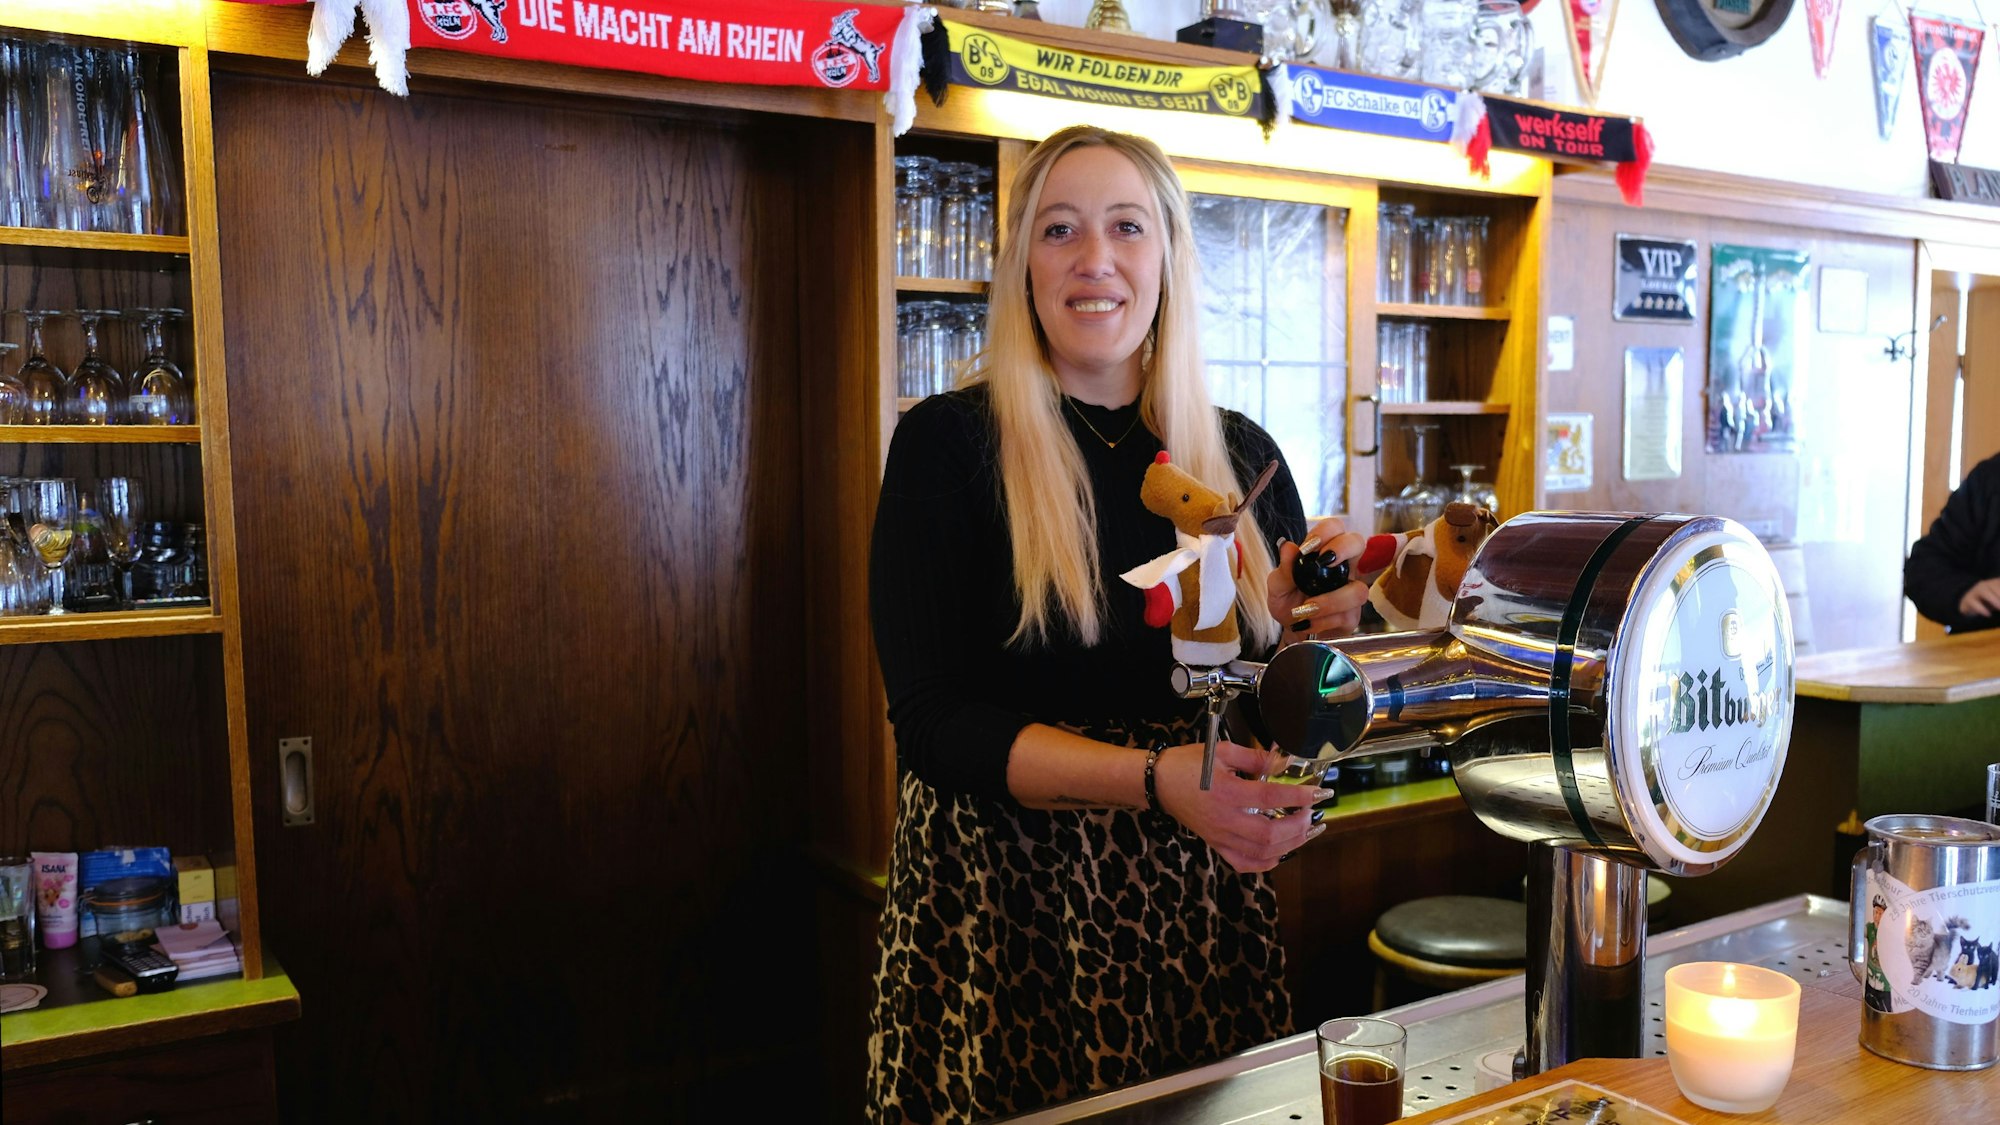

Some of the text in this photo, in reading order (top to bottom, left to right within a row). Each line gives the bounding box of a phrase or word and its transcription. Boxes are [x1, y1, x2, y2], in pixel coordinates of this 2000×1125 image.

[518, 0, 805, 62] DIE MACHT AM RHEIN
[980, 65, 995, 79] 09
[1036, 49, 1184, 88] WIR FOLGEN DIR
[1015, 70, 1210, 112] EGAL WOHIN ES GEHT
[1324, 87, 1420, 117] FC Schalke 04
[1514, 112, 1606, 142] werkself
[1519, 133, 1605, 157] ON TOUR
[1638, 247, 1683, 278] VIP
[1678, 744, 1734, 781] Premium
[41, 863, 67, 873] ISANA
[1899, 897, 1927, 913] Jahre
[1907, 987, 1920, 998] 20
[1922, 994, 1948, 1013] Jahre
[1950, 1004, 1989, 1017] Tierheim
